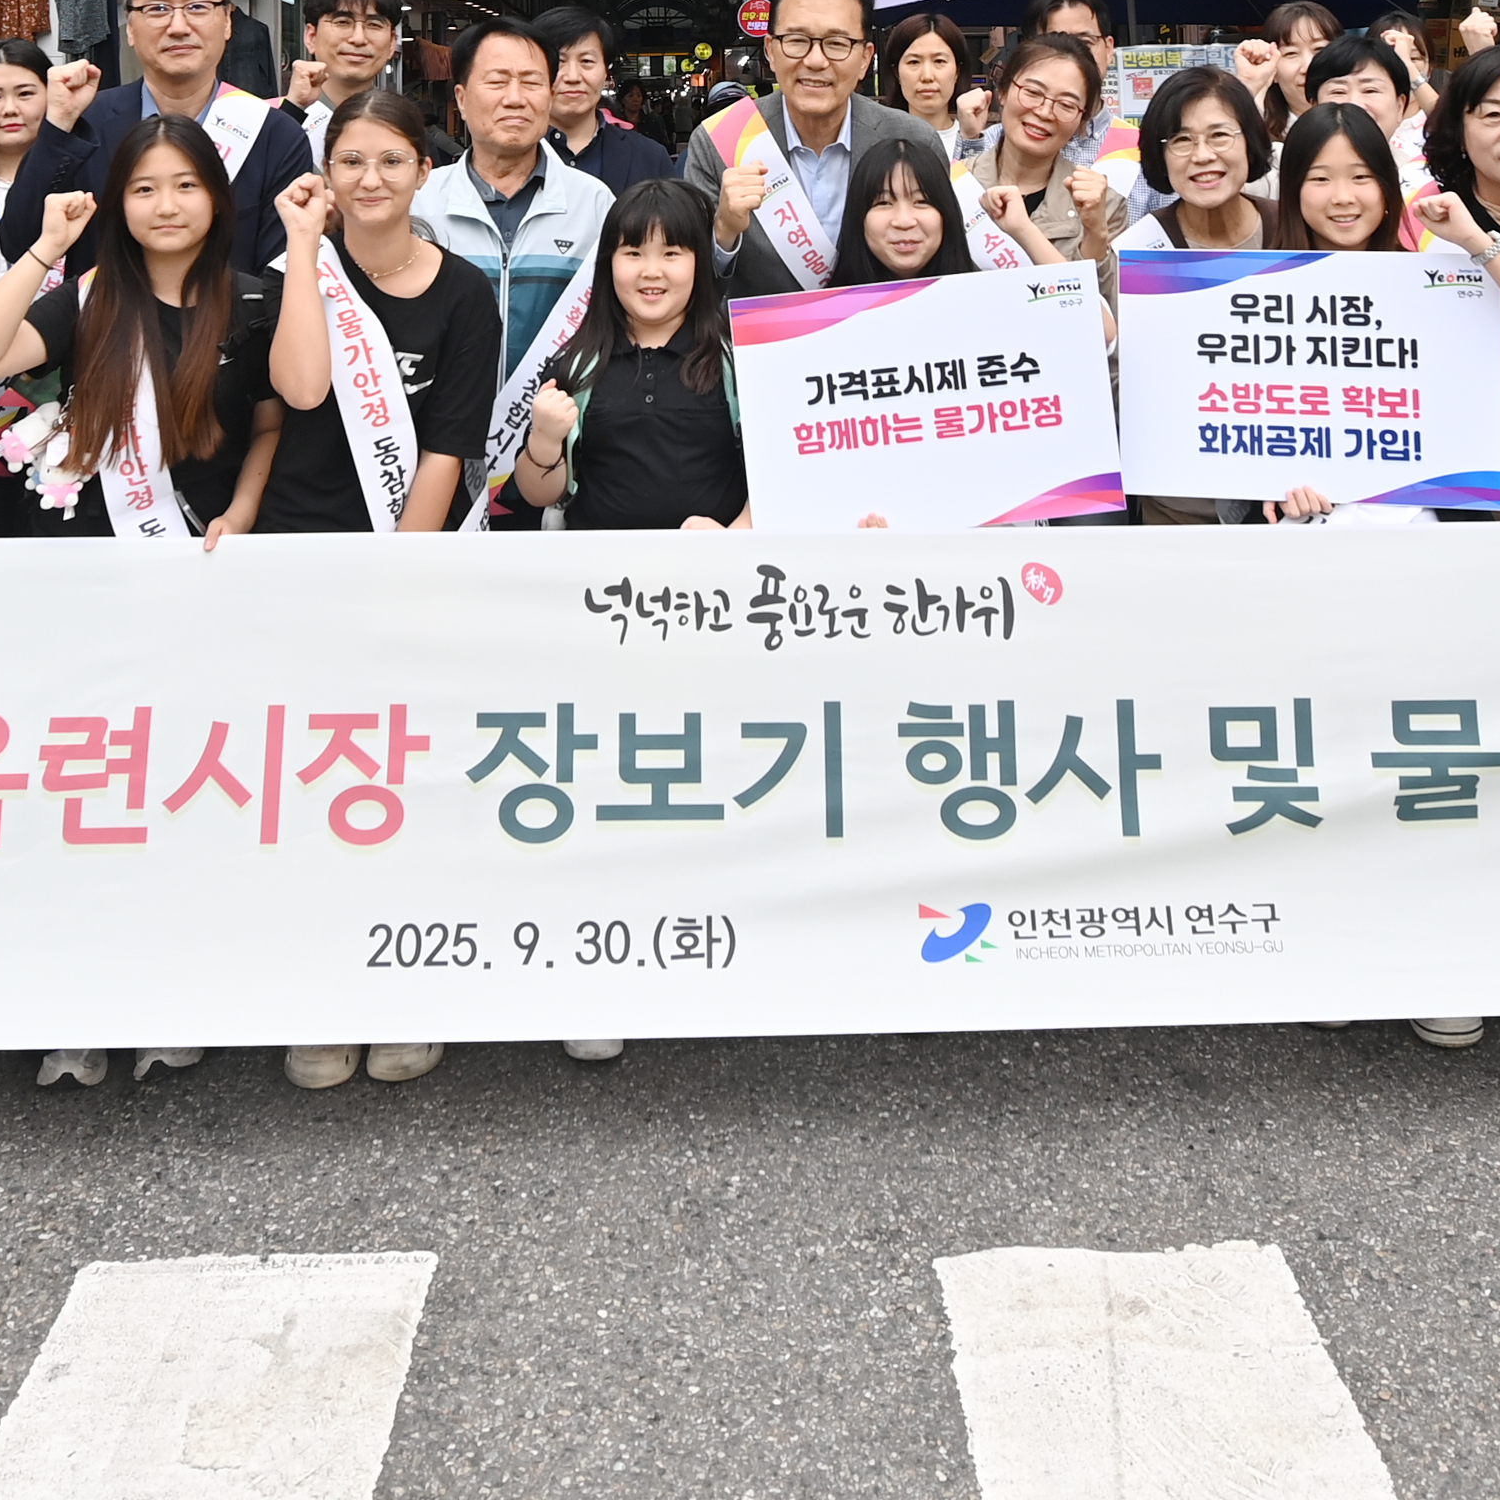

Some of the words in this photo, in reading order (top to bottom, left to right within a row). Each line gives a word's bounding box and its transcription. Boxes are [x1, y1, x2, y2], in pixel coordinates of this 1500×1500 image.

[215, 114, 251, 140] Yeonsu
[1026, 280, 1082, 298] Yeonsu
[1424, 269, 1483, 286] Yeonsu
[1456, 288, 1484, 299] 연수구
[1059, 298, 1083, 308] 연수구
[1230, 293, 1295, 327] 우리
[1305, 296, 1383, 331] 시장,
[316, 261, 391, 428] 지역물가안정
[1197, 333, 1297, 367] 우리가
[1306, 336, 1419, 370] 지킨다!
[806, 359, 968, 407] 가격표시제
[977, 352, 1041, 388] 준수
[1197, 382, 1331, 417] 소방도로
[1342, 384, 1421, 420] 확보!
[793, 413, 924, 456] 함께하는
[934, 395, 1064, 440] 물가안정
[1198, 424, 1333, 460] 화재공제
[1344, 426, 1423, 462] 가입!
[586, 577, 733, 646] 넉넉하고
[745, 563, 872, 653] 풍요로운
[883, 575, 1018, 642] 한가위
[464, 700, 845, 844] 장보기
[898, 698, 1162, 840] 행사
[1207, 697, 1323, 837] 및
[1005, 905, 1175, 941] 인천광역시
[1184, 903, 1282, 936] 연수구
[366, 922, 493, 970] 2025.
[512, 920, 555, 969] 9.
[574, 914, 738, 969] 30.(화)
[1015, 943, 1080, 961] INCHEON
[1085, 941, 1191, 959] METROPOLITAN
[1197, 938, 1285, 957] YEONSU-GU
